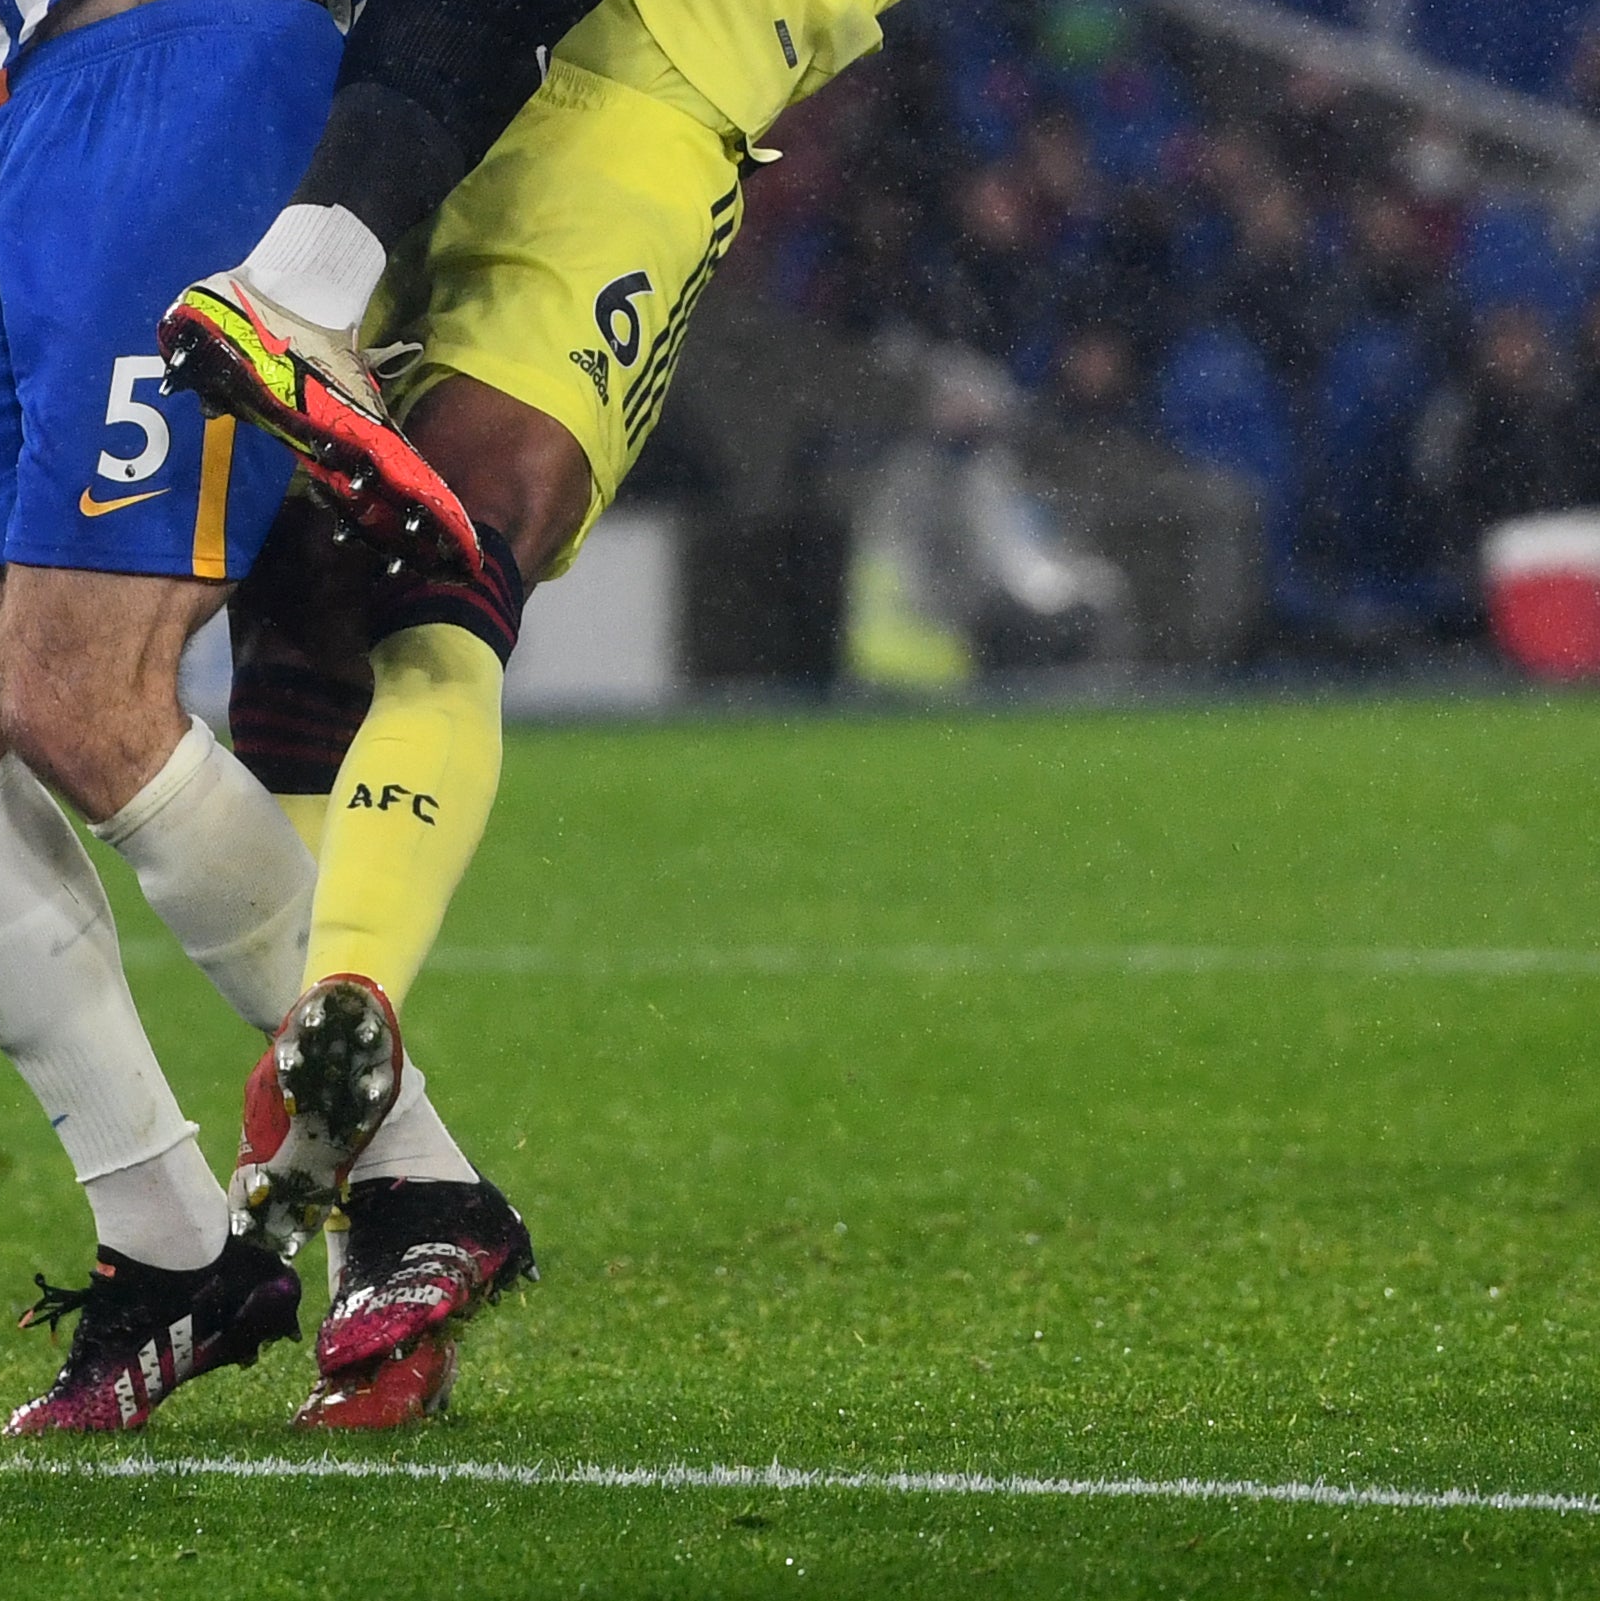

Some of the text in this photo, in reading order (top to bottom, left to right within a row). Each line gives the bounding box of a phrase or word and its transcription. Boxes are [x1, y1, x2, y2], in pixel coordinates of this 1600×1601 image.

[594, 269, 654, 369] 6
[96, 355, 170, 483] 5
[347, 783, 440, 826] AFC
